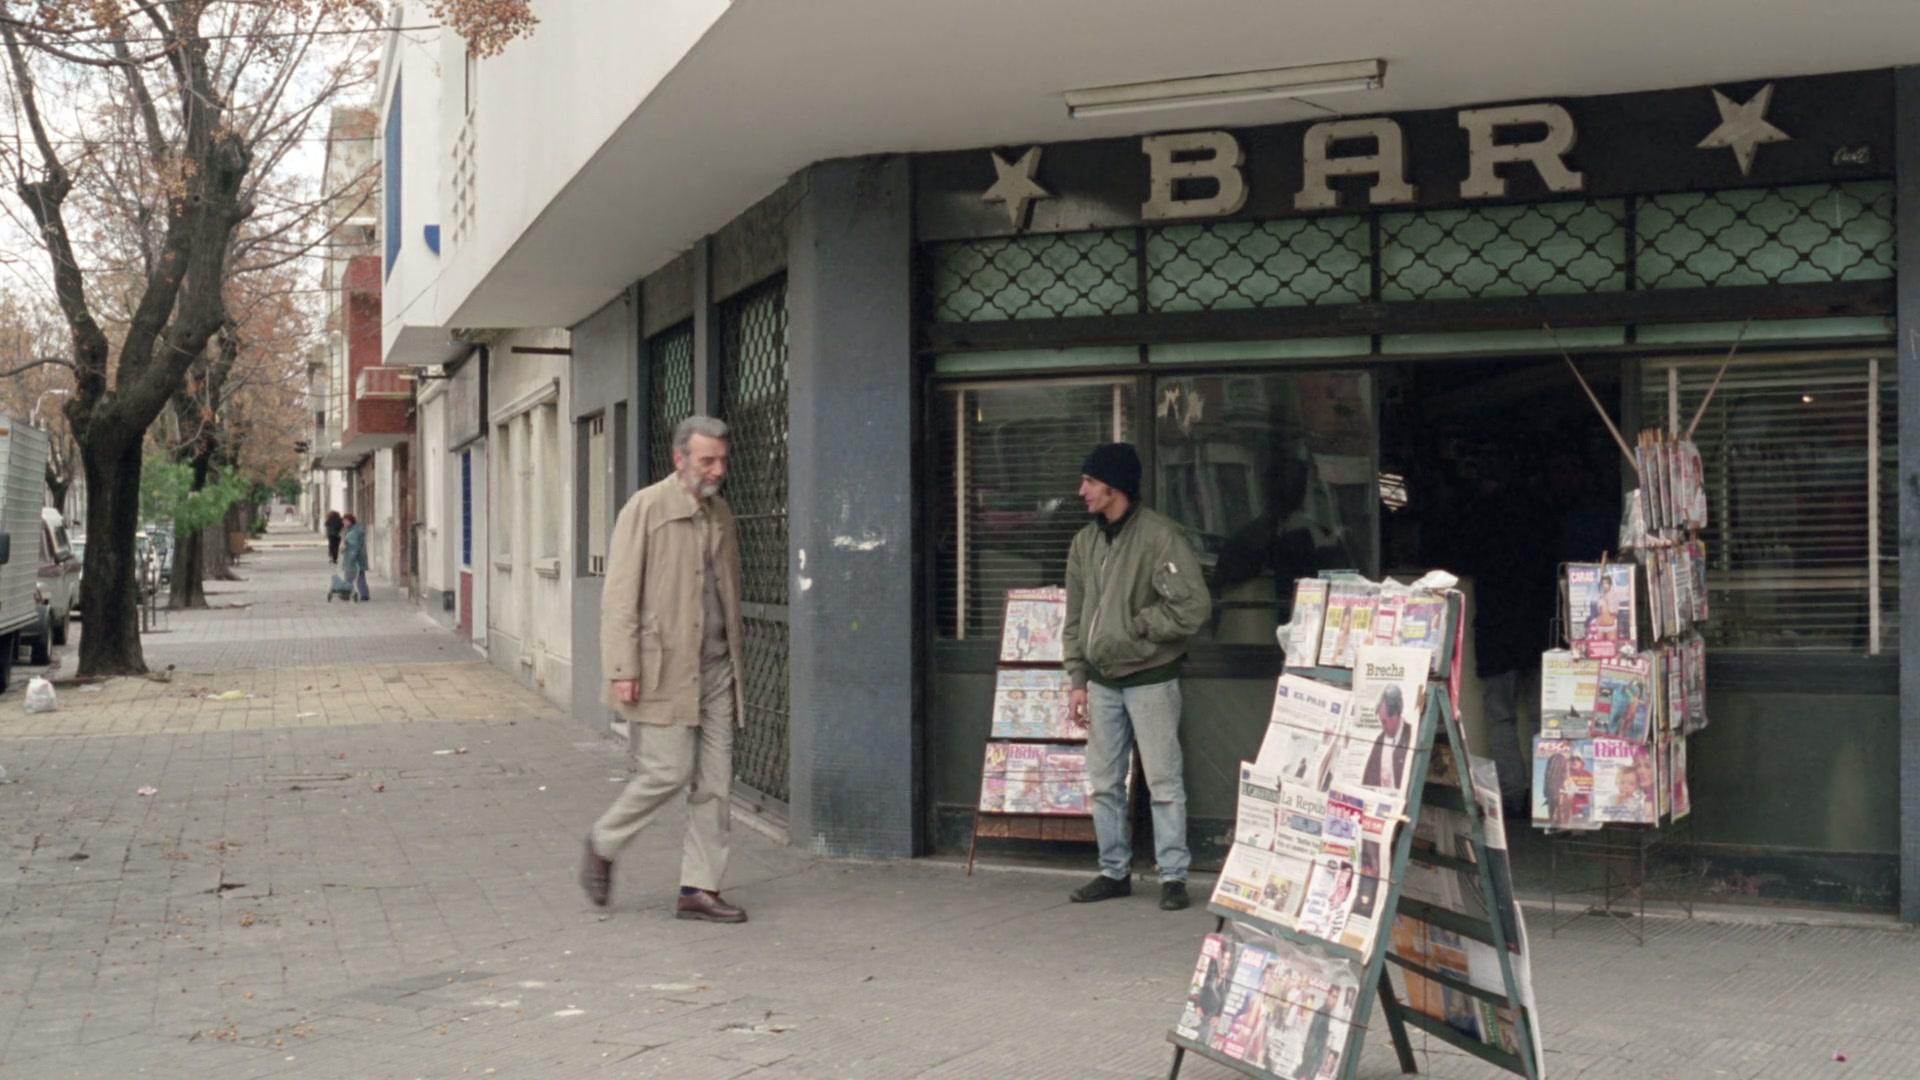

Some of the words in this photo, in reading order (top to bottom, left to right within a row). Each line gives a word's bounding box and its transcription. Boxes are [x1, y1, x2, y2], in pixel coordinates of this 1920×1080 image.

[1141, 103, 1585, 220] BAR
[1366, 663, 1405, 677] Brecha
[1280, 791, 1292, 806] La
